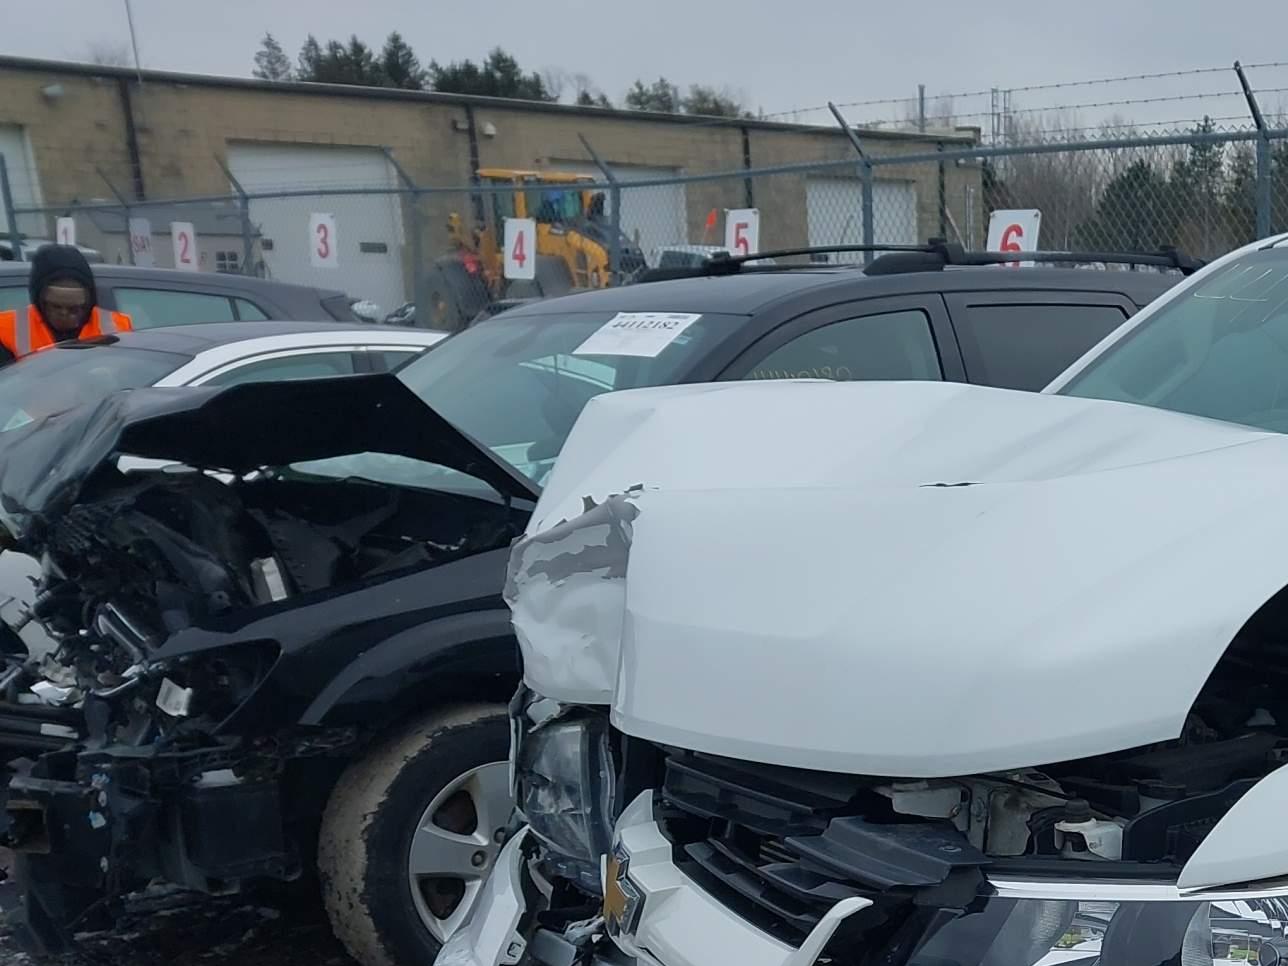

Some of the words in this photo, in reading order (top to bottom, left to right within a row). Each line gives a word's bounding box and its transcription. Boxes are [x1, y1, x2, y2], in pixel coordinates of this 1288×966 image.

[178, 231, 191, 263] 2
[317, 223, 330, 259] 3
[512, 230, 526, 268] 4
[734, 223, 749, 257] 5
[1001, 224, 1023, 266] 6
